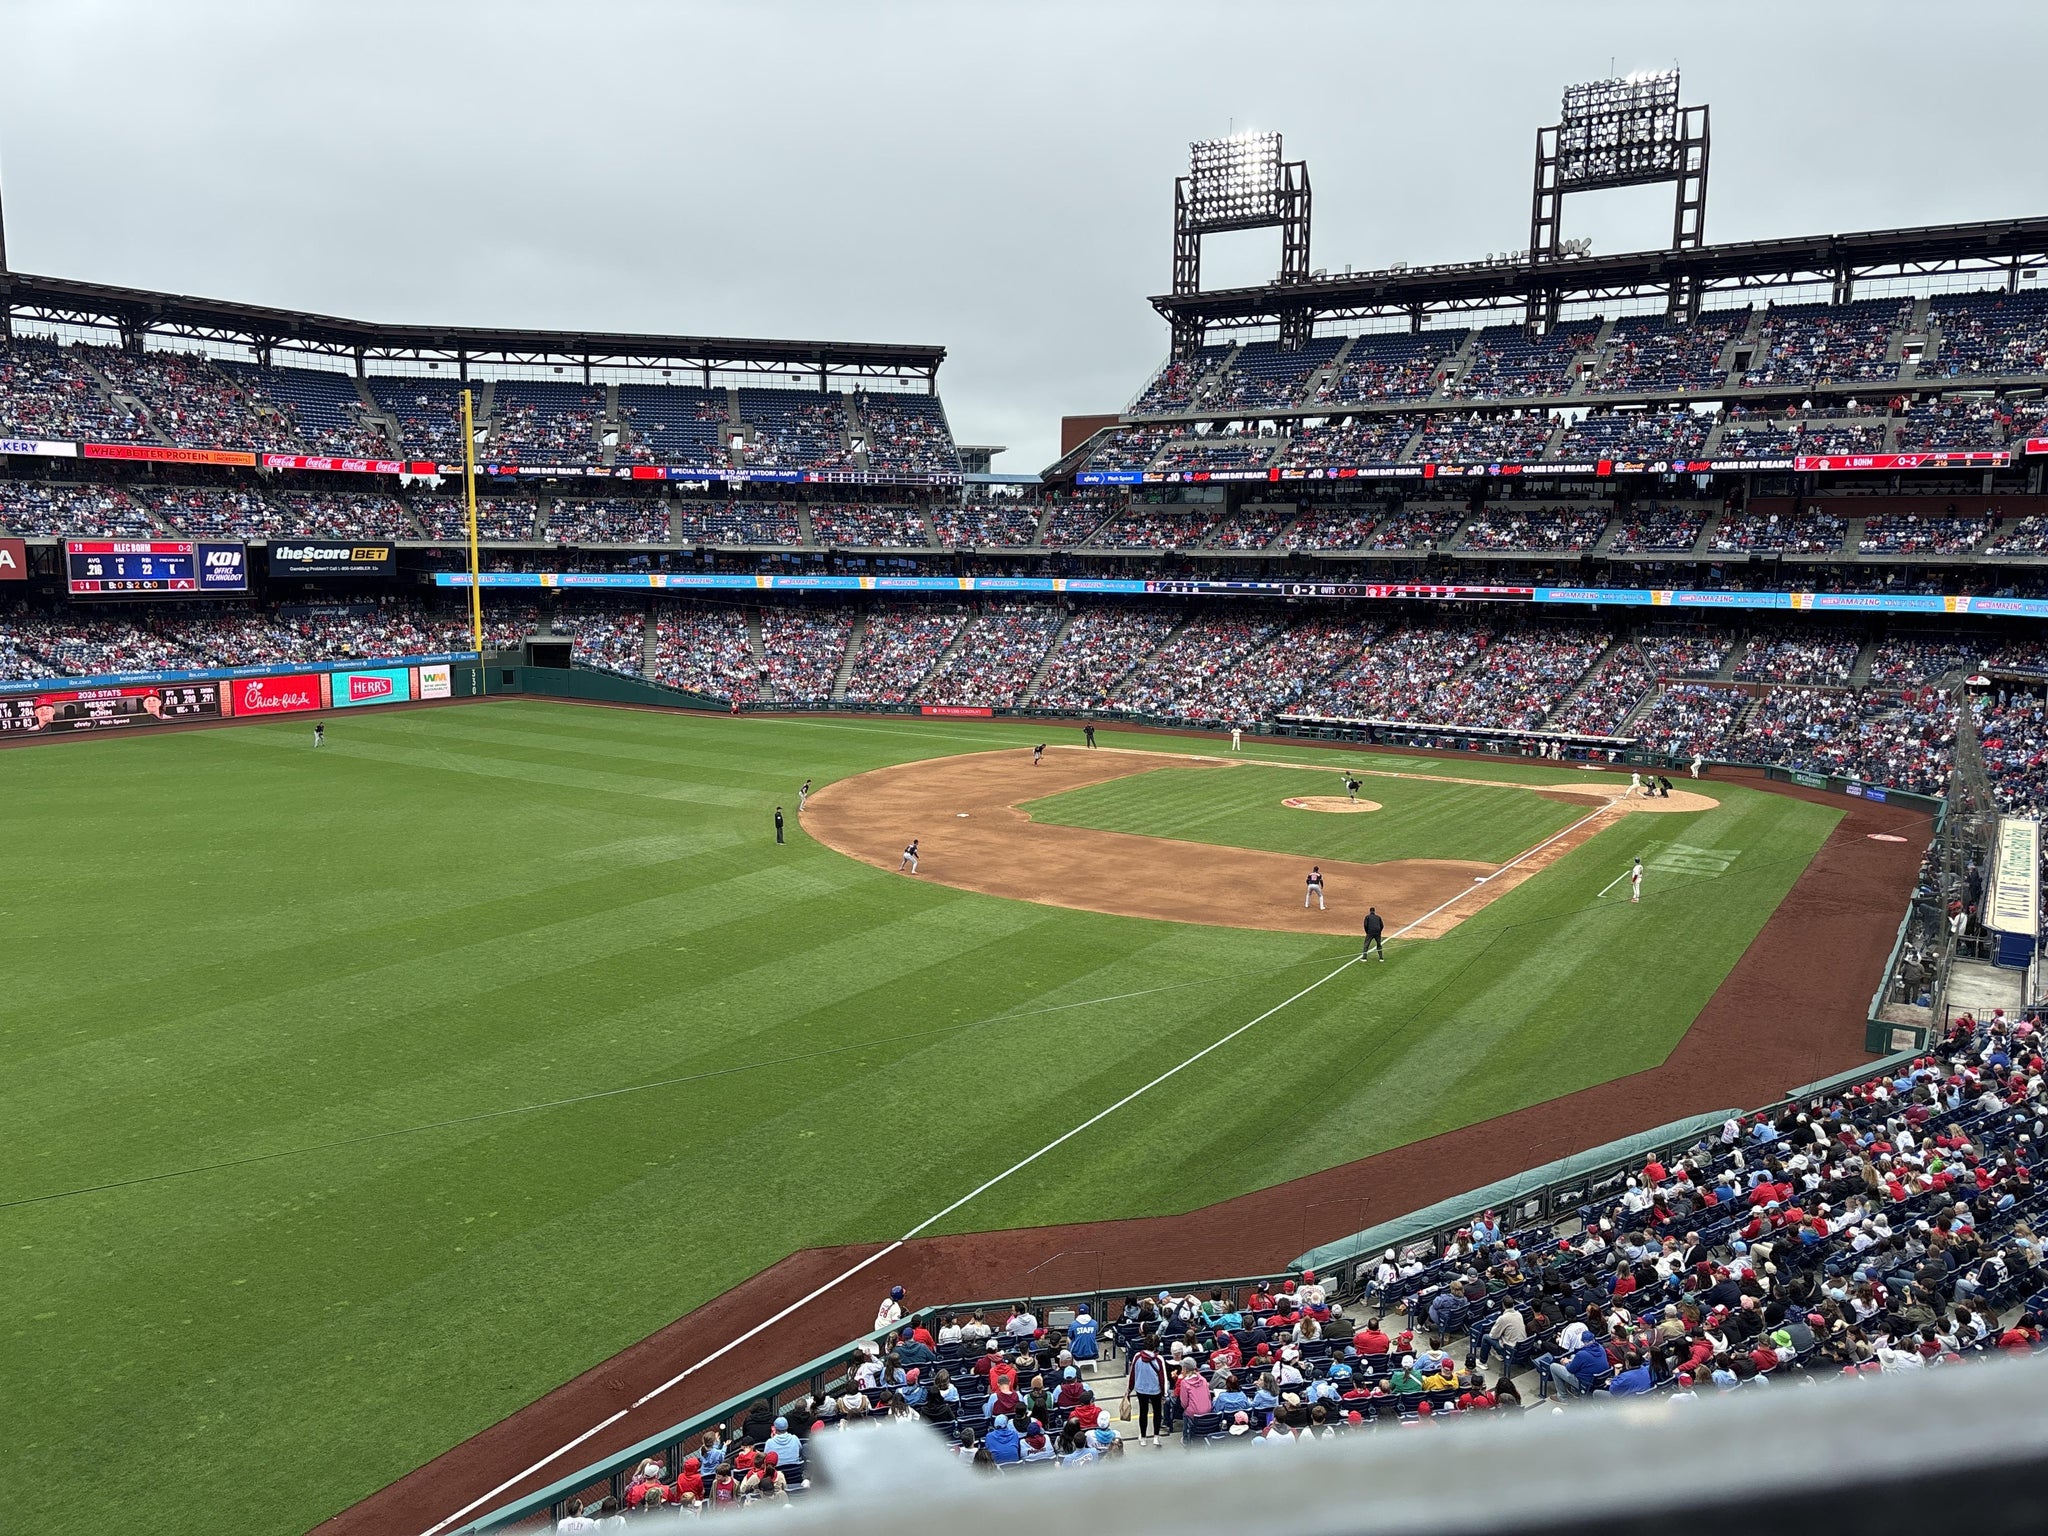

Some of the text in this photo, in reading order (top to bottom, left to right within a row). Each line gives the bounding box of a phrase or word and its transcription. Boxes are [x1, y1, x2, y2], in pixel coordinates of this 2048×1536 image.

[91, 447, 209, 461] WHEY BETTER PROTEIN
[268, 455, 296, 467] Coca-Cola
[306, 457, 333, 469] Coca-Cola
[341, 459, 368, 471] Coca-Cola
[1711, 460, 1794, 470] GAME DAY READY.
[1845, 458, 1873, 467] A. BOHM
[1898, 457, 1917, 465] 0-2
[376, 461, 400, 472] Coca-Cola
[1523, 464, 1594, 473] GAME DAY READY.
[1210, 472, 1229, 480] GAME
[1380, 468, 1395, 476] DAY
[114, 543, 130, 552] ALEC
[131, 543, 151, 552] BOHM
[276, 546, 386, 560] theScore BET
[206, 551, 241, 566] KDI
[87, 564, 176, 575] .216 5 22 K
[1840, 598, 1880, 606] AMAZING
[1991, 602, 2022, 610] AMAZING
[423, 673, 447, 682] WM
[353, 680, 388, 694] HERR'S
[78, 689, 121, 699] 2026 STATS
[244, 686, 310, 710] Chick-fil-A
[84, 700, 116, 709] MESSICK
[90, 709, 112, 718] BOHM
[74, 721, 91, 729] xfinity
[1801, 774, 1821, 785] Citizens
[1996, 881, 2030, 919] WELCOME
[1485, 1231, 1492, 1242] 3
[1076, 1326, 1094, 1335] STAFF
